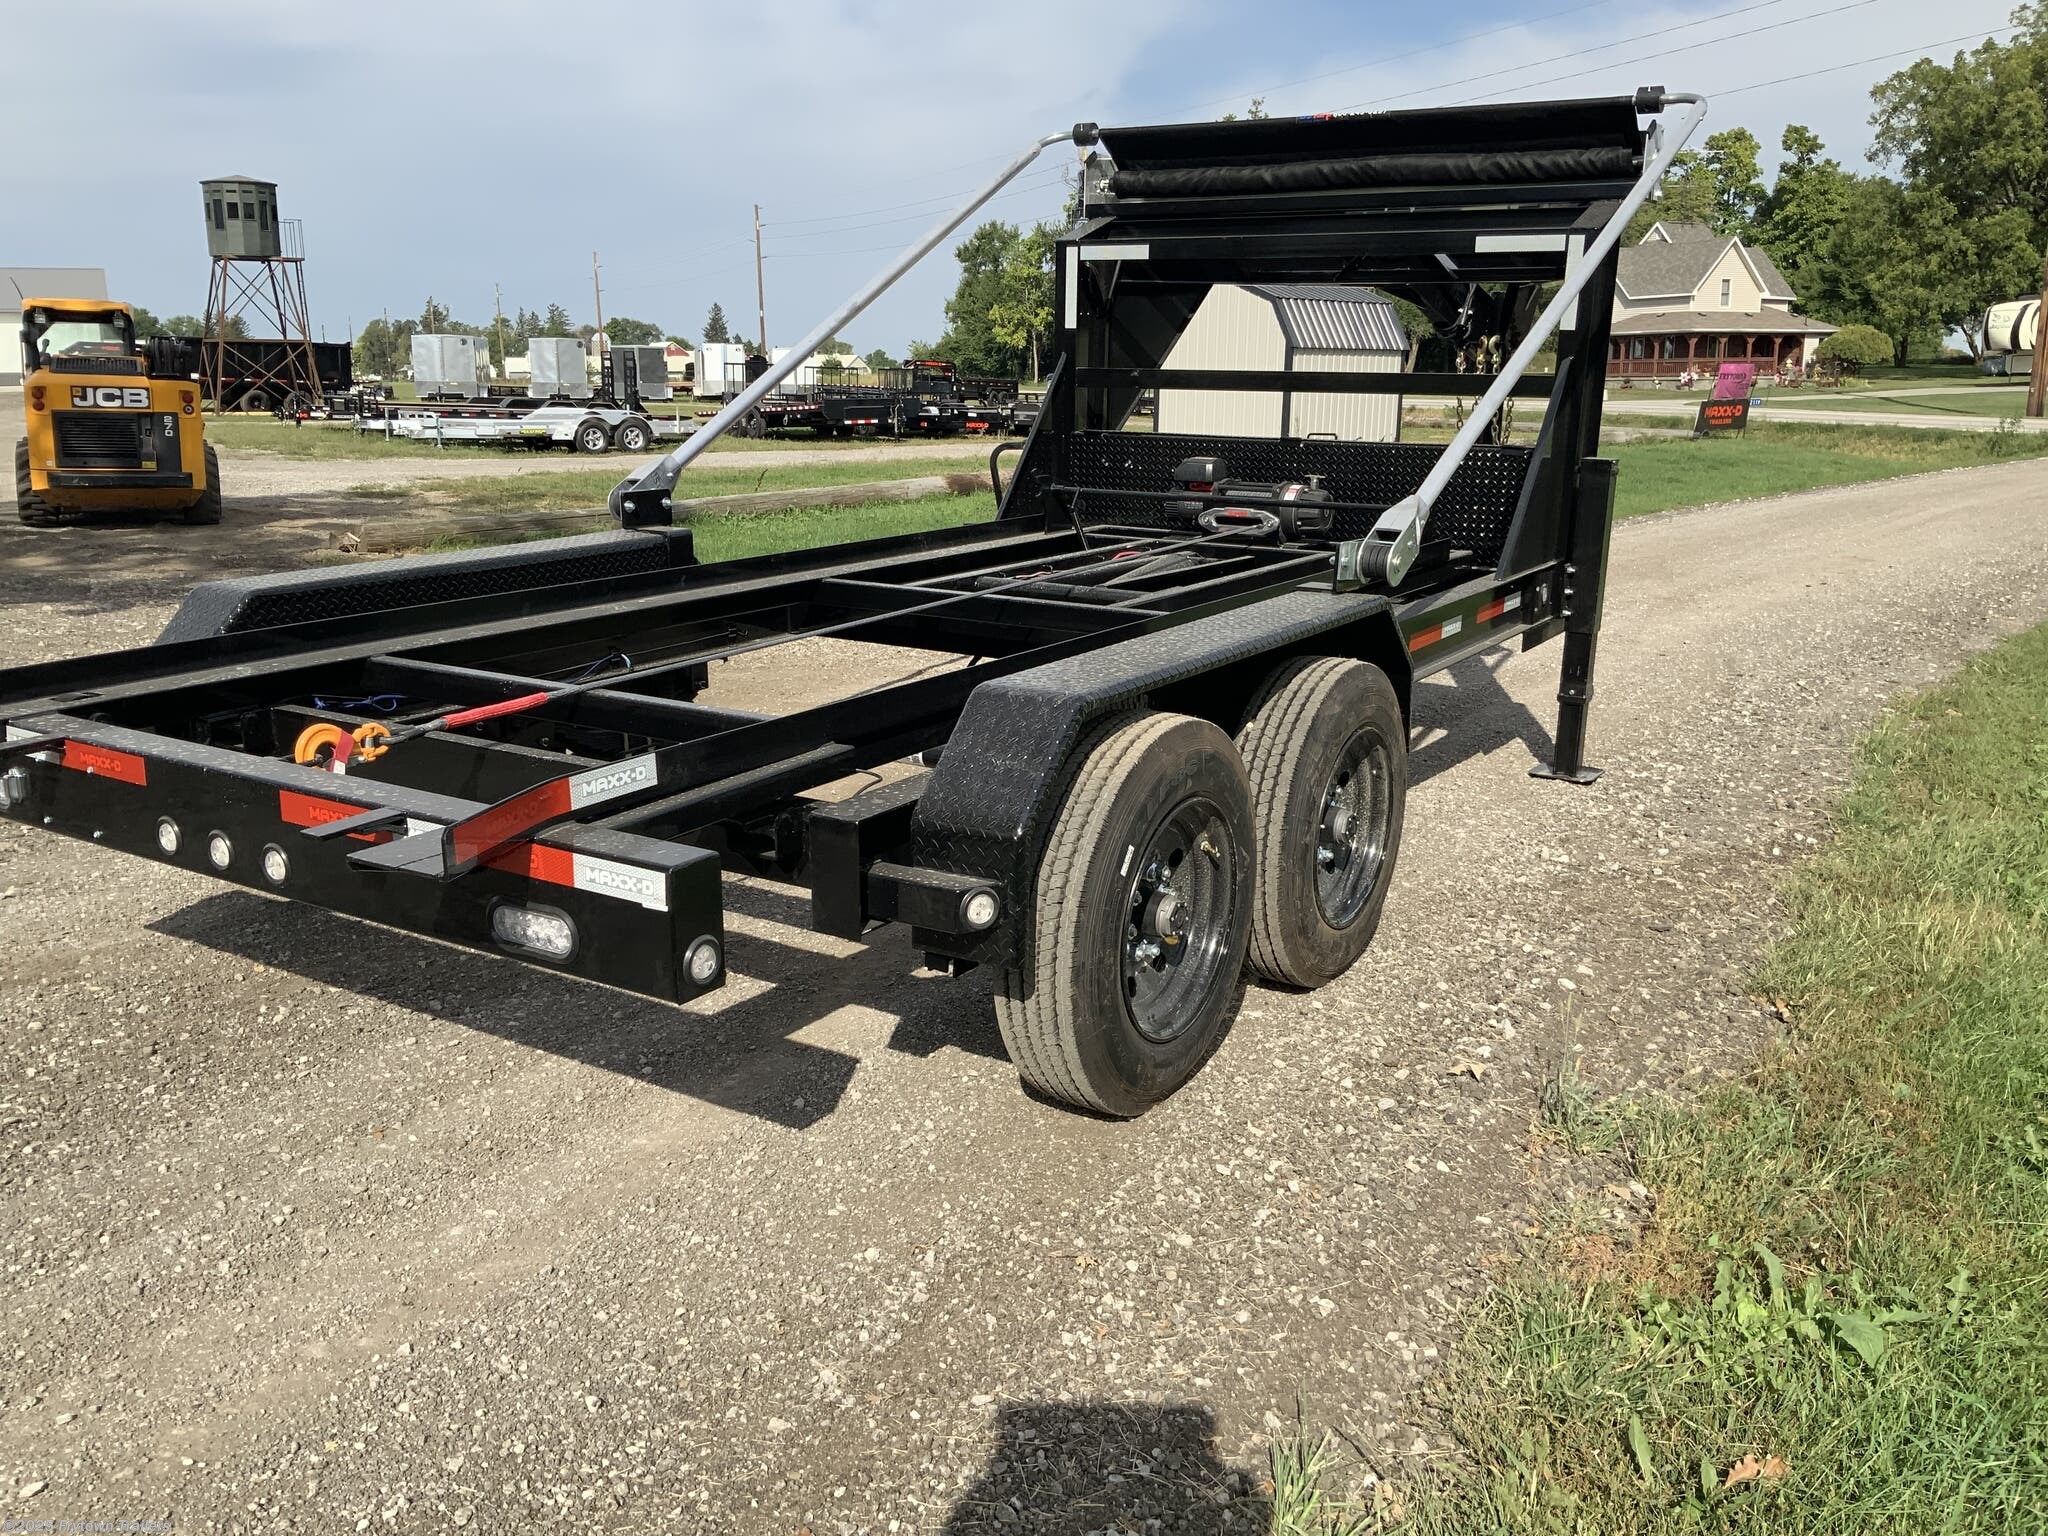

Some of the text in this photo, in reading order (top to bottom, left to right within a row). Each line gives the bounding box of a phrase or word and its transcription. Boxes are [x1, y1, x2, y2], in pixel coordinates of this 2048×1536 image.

[73, 387, 149, 407] JCB
[164, 415, 173, 437] 270
[80, 752, 121, 771] MAXX-D
[582, 765, 647, 797] MAXX-D
[585, 865, 654, 896] MAXX-D
